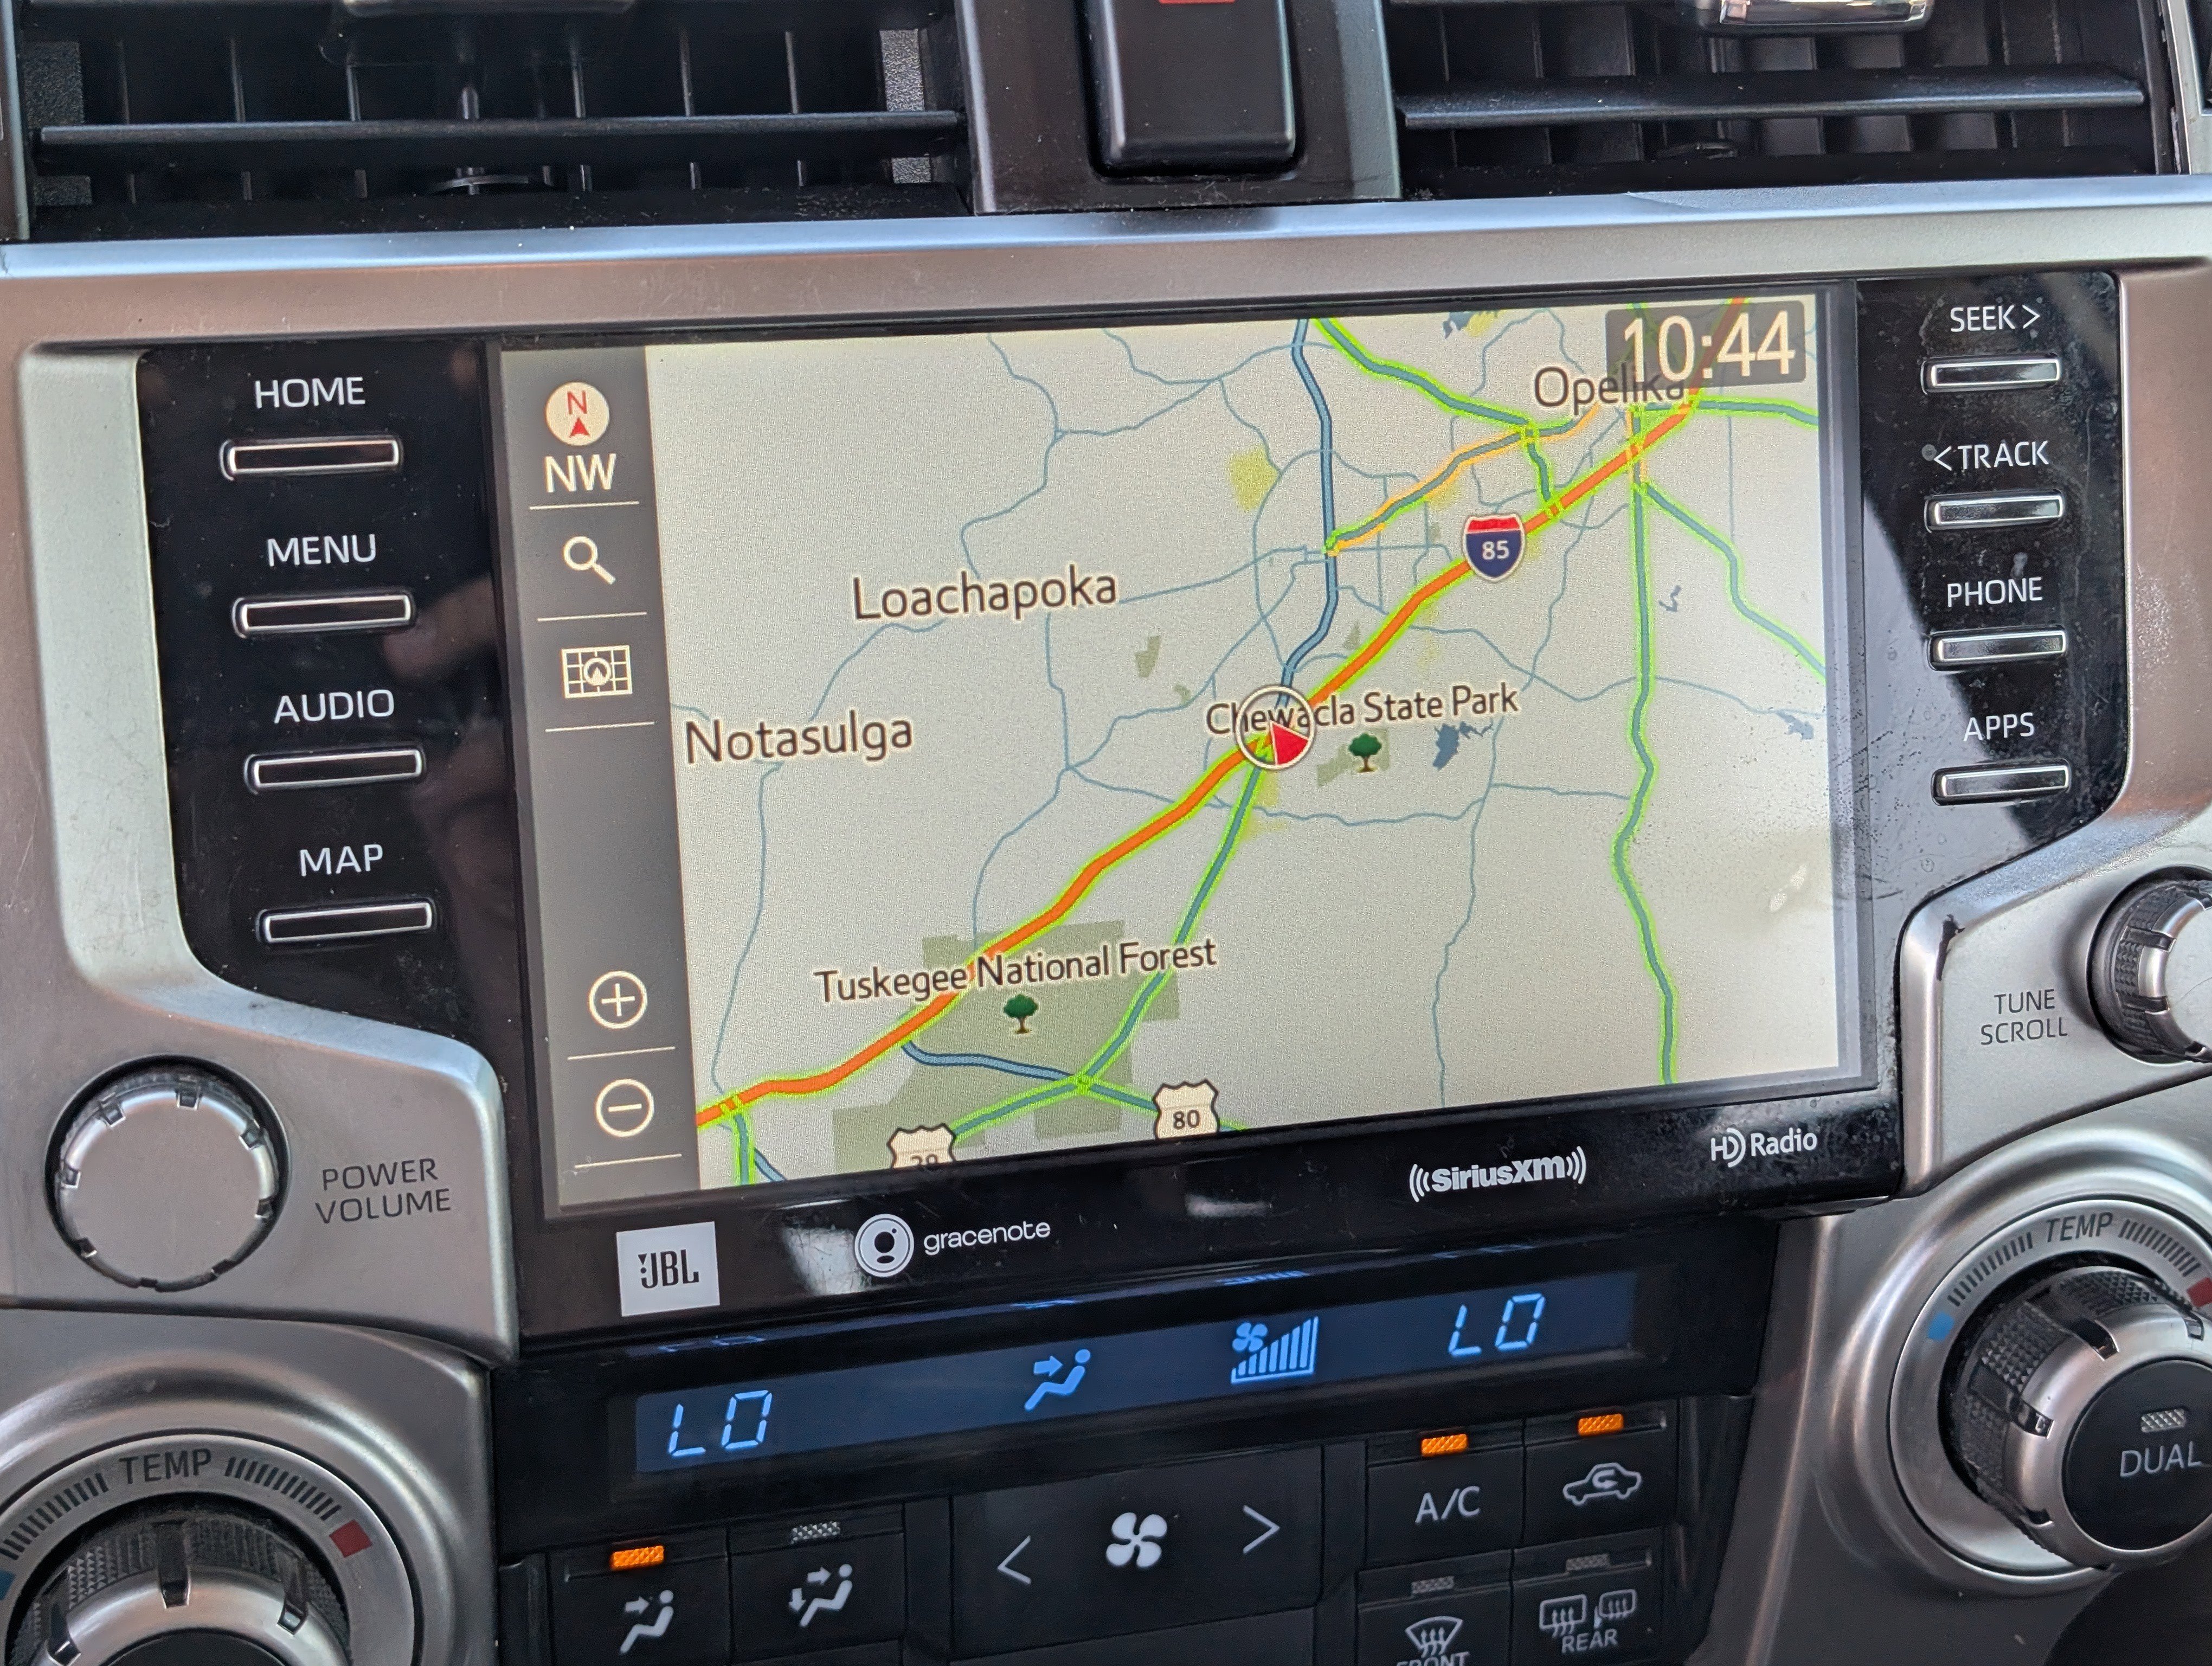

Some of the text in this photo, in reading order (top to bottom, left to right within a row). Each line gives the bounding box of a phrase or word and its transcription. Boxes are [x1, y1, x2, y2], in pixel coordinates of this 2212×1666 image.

[1950, 304, 2016, 333] SEEK
[1623, 309, 1796, 384] 10:44
[254, 376, 366, 409] HOME
[567, 390, 588, 415] N
[1533, 364, 1686, 416] Opelika
[1957, 440, 2049, 470] TRACK
[544, 453, 616, 493] NW
[267, 533, 377, 567] MENU
[1481, 539, 1510, 561] 85
[852, 564, 1118, 621] Loachapoka
[1947, 576, 2043, 608] PHONE
[274, 689, 395, 724] AUDIO
[1206, 682, 1519, 733] Chewacla State Park
[686, 709, 913, 764] Notasulga
[1964, 713, 2035, 742] APPS
[299, 844, 383, 877] MAP
[814, 939, 1218, 1004] Tuskegee National Forest
[1994, 989, 2055, 1014] TUNE
[1980, 1017, 2068, 1045] SCROLL
[1173, 1109, 1201, 1129] 80
[1711, 1127, 1817, 1168] HD Radio
[323, 1158, 438, 1191] POWER
[315, 1188, 451, 1223] VOLUME
[924, 1221, 1051, 1255] gracenote
[2046, 1212, 2113, 1243] TEMP
[638, 1249, 699, 1289] JBL
[119, 1449, 212, 1484] TEMP
[2120, 1441, 2202, 1477] DUAL
[1415, 1486, 1480, 1523] A/C
[1562, 1628, 1618, 1653] REAR
